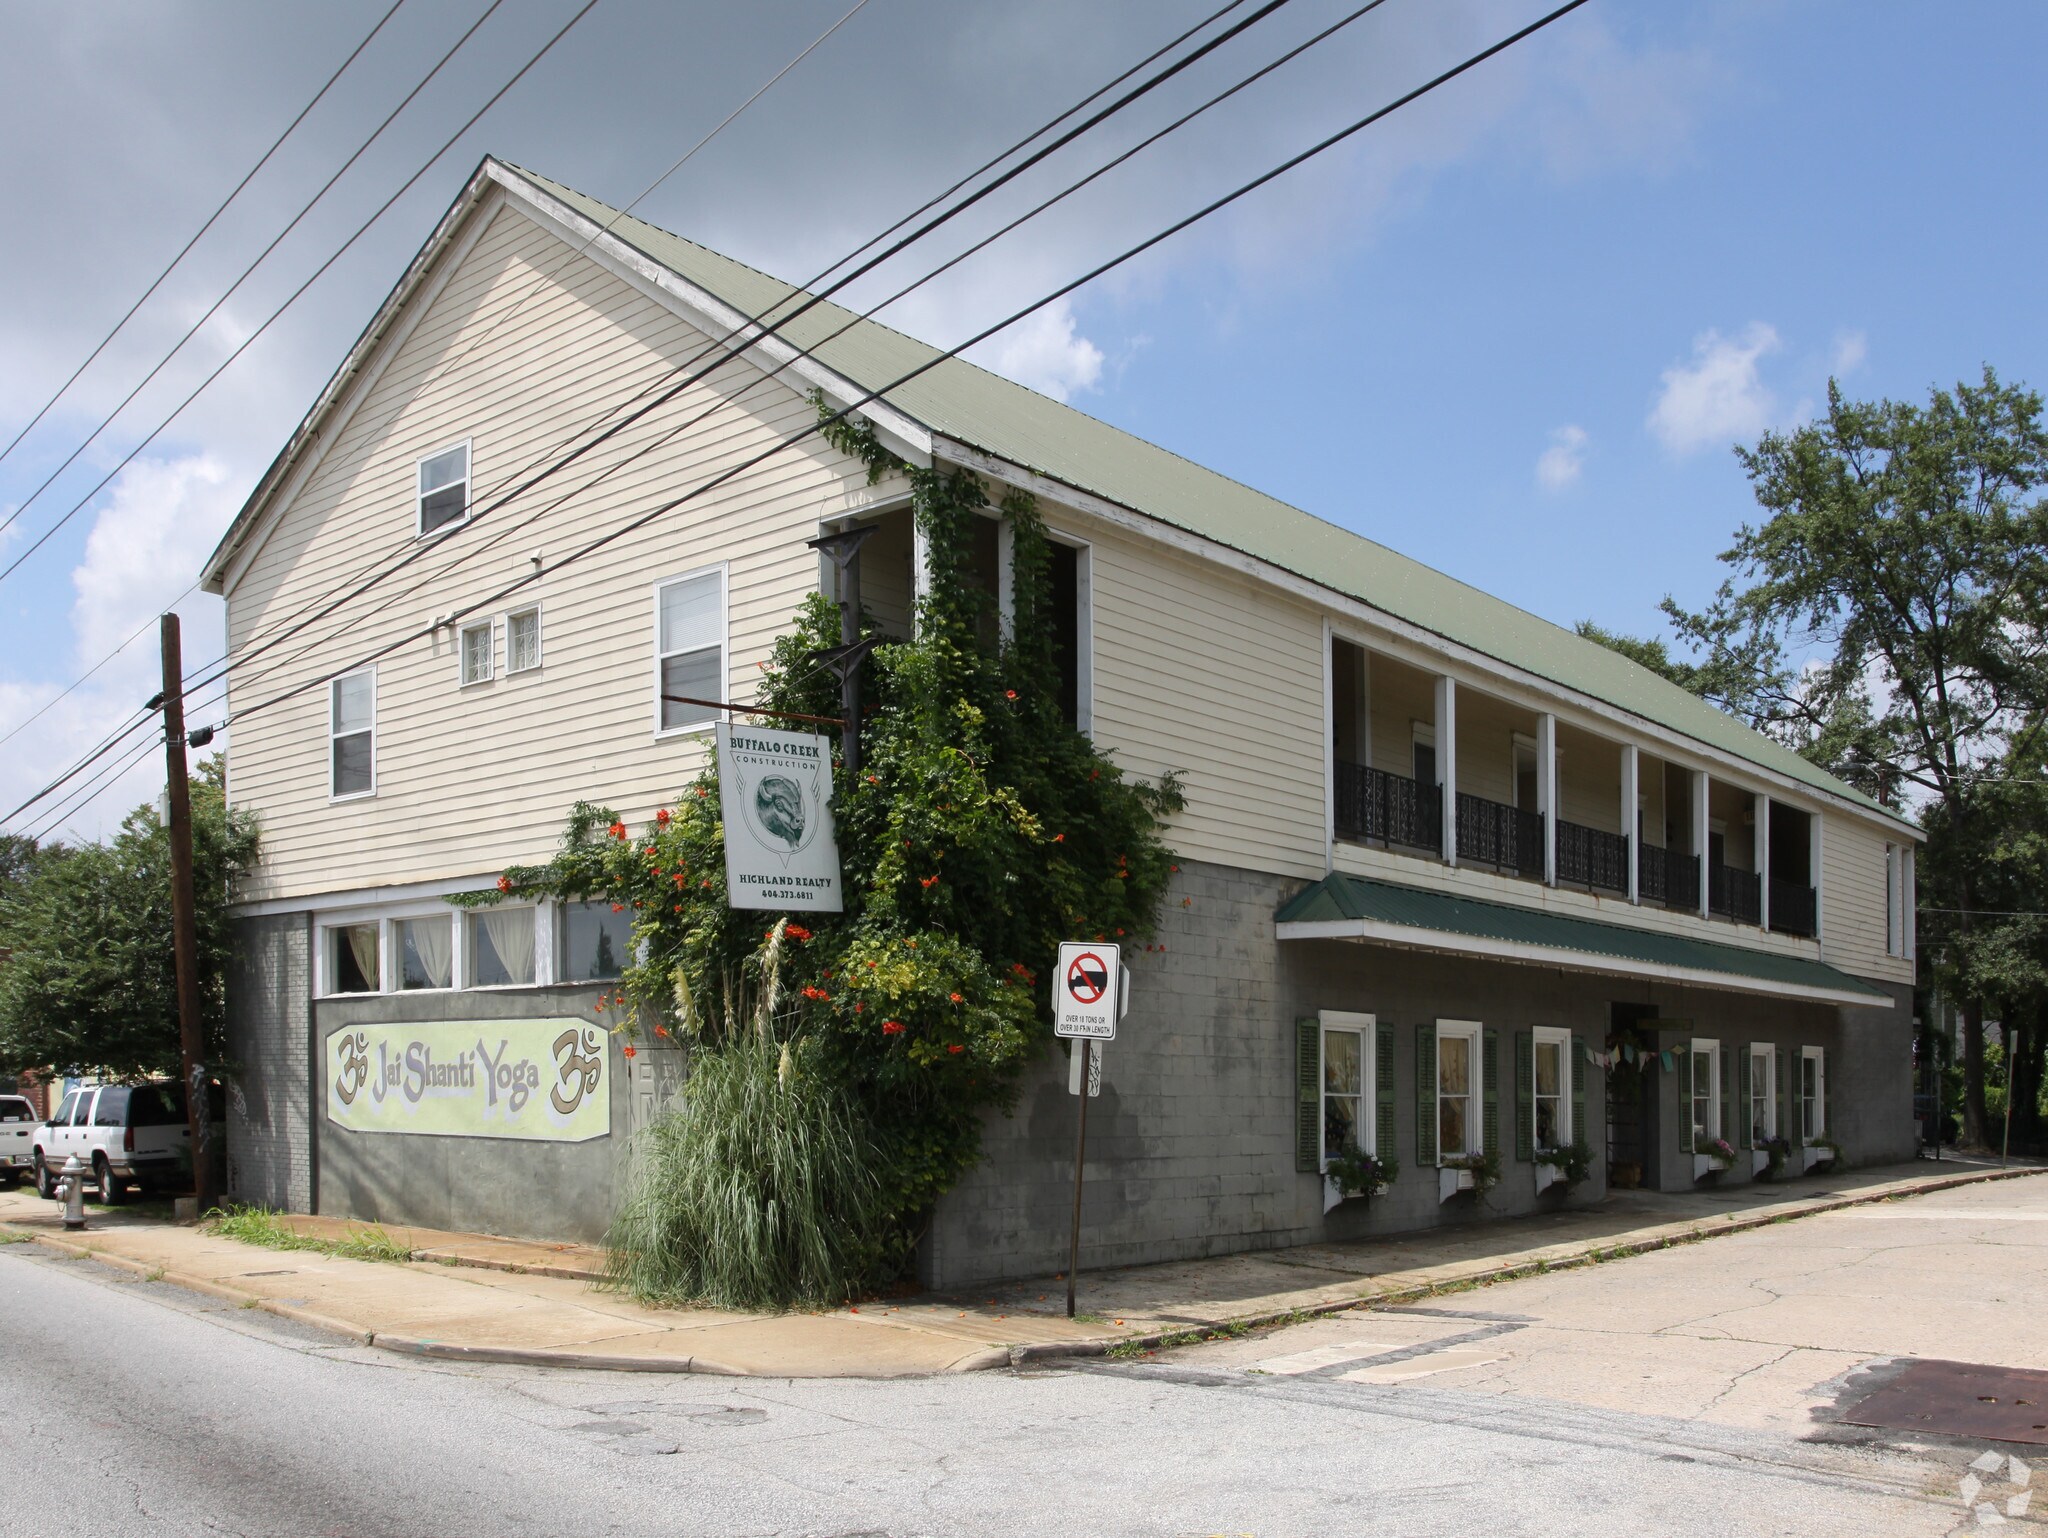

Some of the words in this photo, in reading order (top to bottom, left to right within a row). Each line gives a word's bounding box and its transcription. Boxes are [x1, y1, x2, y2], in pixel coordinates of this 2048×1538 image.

[730, 737, 781, 753] BUFFALO
[784, 743, 819, 758] CREEK
[736, 755, 816, 770] CONSTRUCTION
[739, 874, 793, 886] HIGHLAND
[795, 877, 831, 888] REALTY
[762, 890, 813, 900] 404.373.6811
[1065, 1014, 1078, 1023] OVER
[1085, 1015, 1097, 1024] TONS
[1098, 1016, 1105, 1024] OR
[1059, 1023, 1072, 1032] OVER
[1091, 1025, 1111, 1034] LENGTH
[372, 1039, 401, 1103] Jai
[402, 1041, 476, 1103] Shanti
[475, 1037, 540, 1113] Yoga
